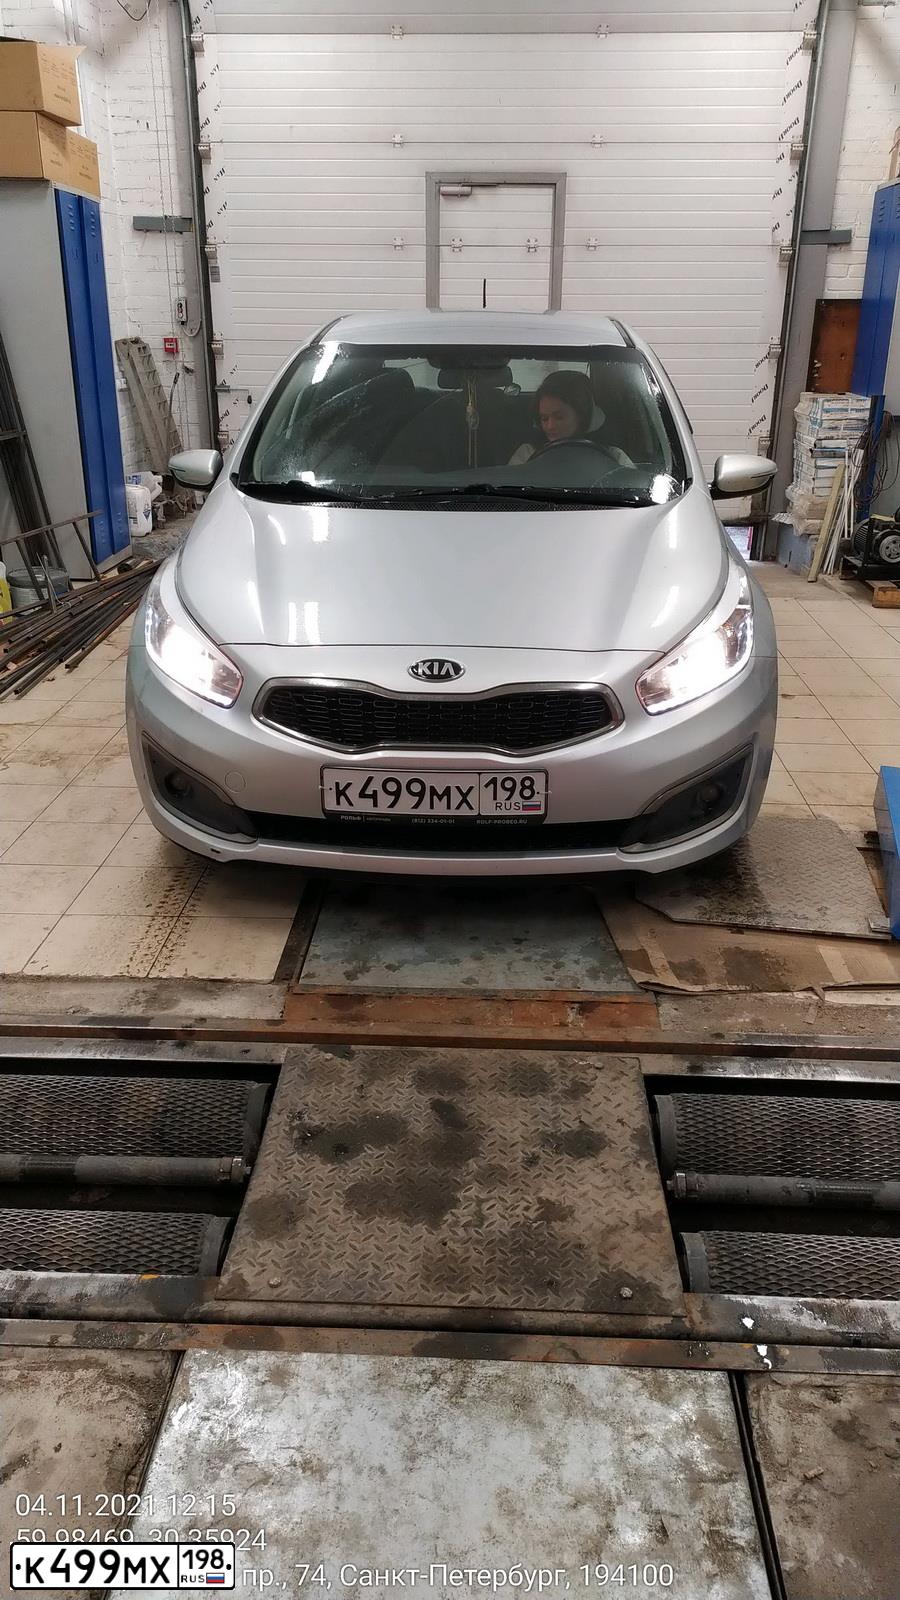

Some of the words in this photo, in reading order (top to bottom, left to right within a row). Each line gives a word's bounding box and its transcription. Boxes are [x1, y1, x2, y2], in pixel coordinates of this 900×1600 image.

[417, 661, 456, 676] KIA
[483, 776, 536, 802] 198
[494, 801, 522, 811] RUS
